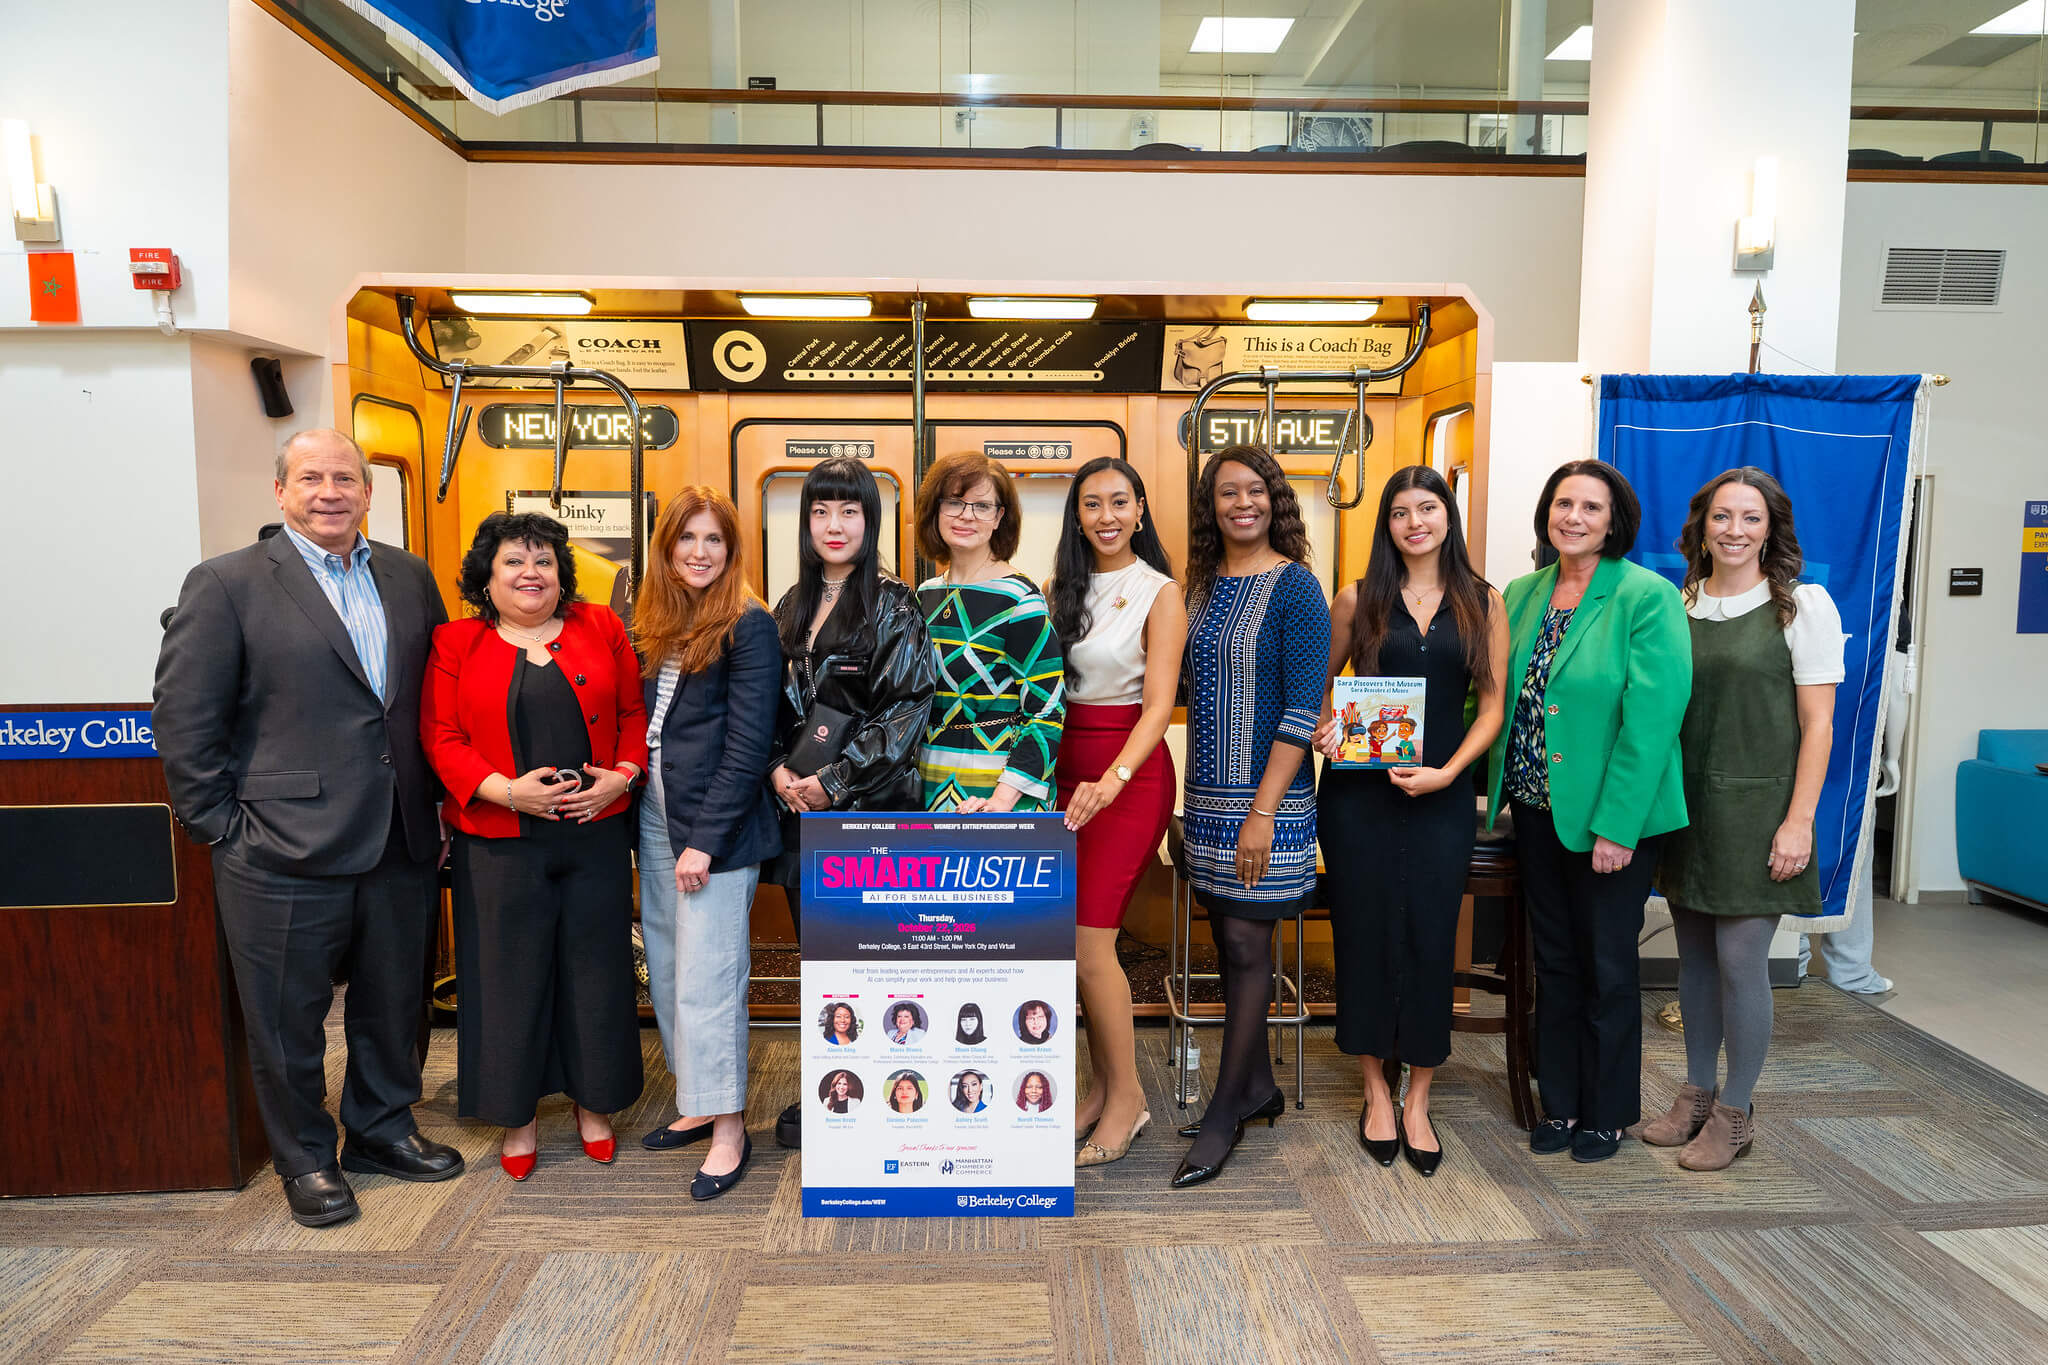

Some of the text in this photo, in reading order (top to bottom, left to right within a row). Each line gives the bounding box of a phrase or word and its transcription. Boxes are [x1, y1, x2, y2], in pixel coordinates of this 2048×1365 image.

[578, 338, 661, 348] COACH
[788, 338, 821, 367] Central Park
[819, 341, 837, 357] Street
[847, 336, 883, 367] Times Square
[867, 334, 906, 368] Lincoln Center
[924, 334, 945, 353] Central
[968, 332, 1009, 368] Bleecker Street
[987, 333, 1029, 367] West 4th Street
[1008, 337, 1044, 367] Spring Street
[1028, 330, 1072, 367] Columbus Circle
[1094, 332, 1138, 368] Brooklyn Bridge
[1243, 336, 1392, 357] This is a Coach Bag
[828, 340, 859, 368] Bryant Park
[888, 354, 902, 368] 23rd
[900, 344, 914, 357] Stre
[928, 354, 943, 368] Astor
[942, 341, 959, 356] Place
[948, 342, 977, 368] 14th Street
[1210, 418, 1267, 445] 5TH
[789, 446, 828, 455] Please do
[987, 447, 1026, 456] Please do
[558, 504, 606, 523] Dinky
[590, 523, 604, 533] bag
[871, 847, 888, 855] THE
[898, 922, 976, 934] October 22, 2026
[918, 913, 955, 923] Thursday,
[858, 943, 880, 951] Berkeley
[881, 943, 901, 951] College,
[977, 943, 987, 951] City
[880, 967, 899, 975] leading
[920, 967, 956, 976] entrepreneurs
[976, 967, 995, 976] experts
[886, 976, 905, 984] simplify
[945, 976, 956, 984] help
[957, 977, 970, 985] grow
[972, 977, 984, 985] your
[969, 1194, 1015, 1209] Berkeley
[1016, 1194, 1058, 1209] College
